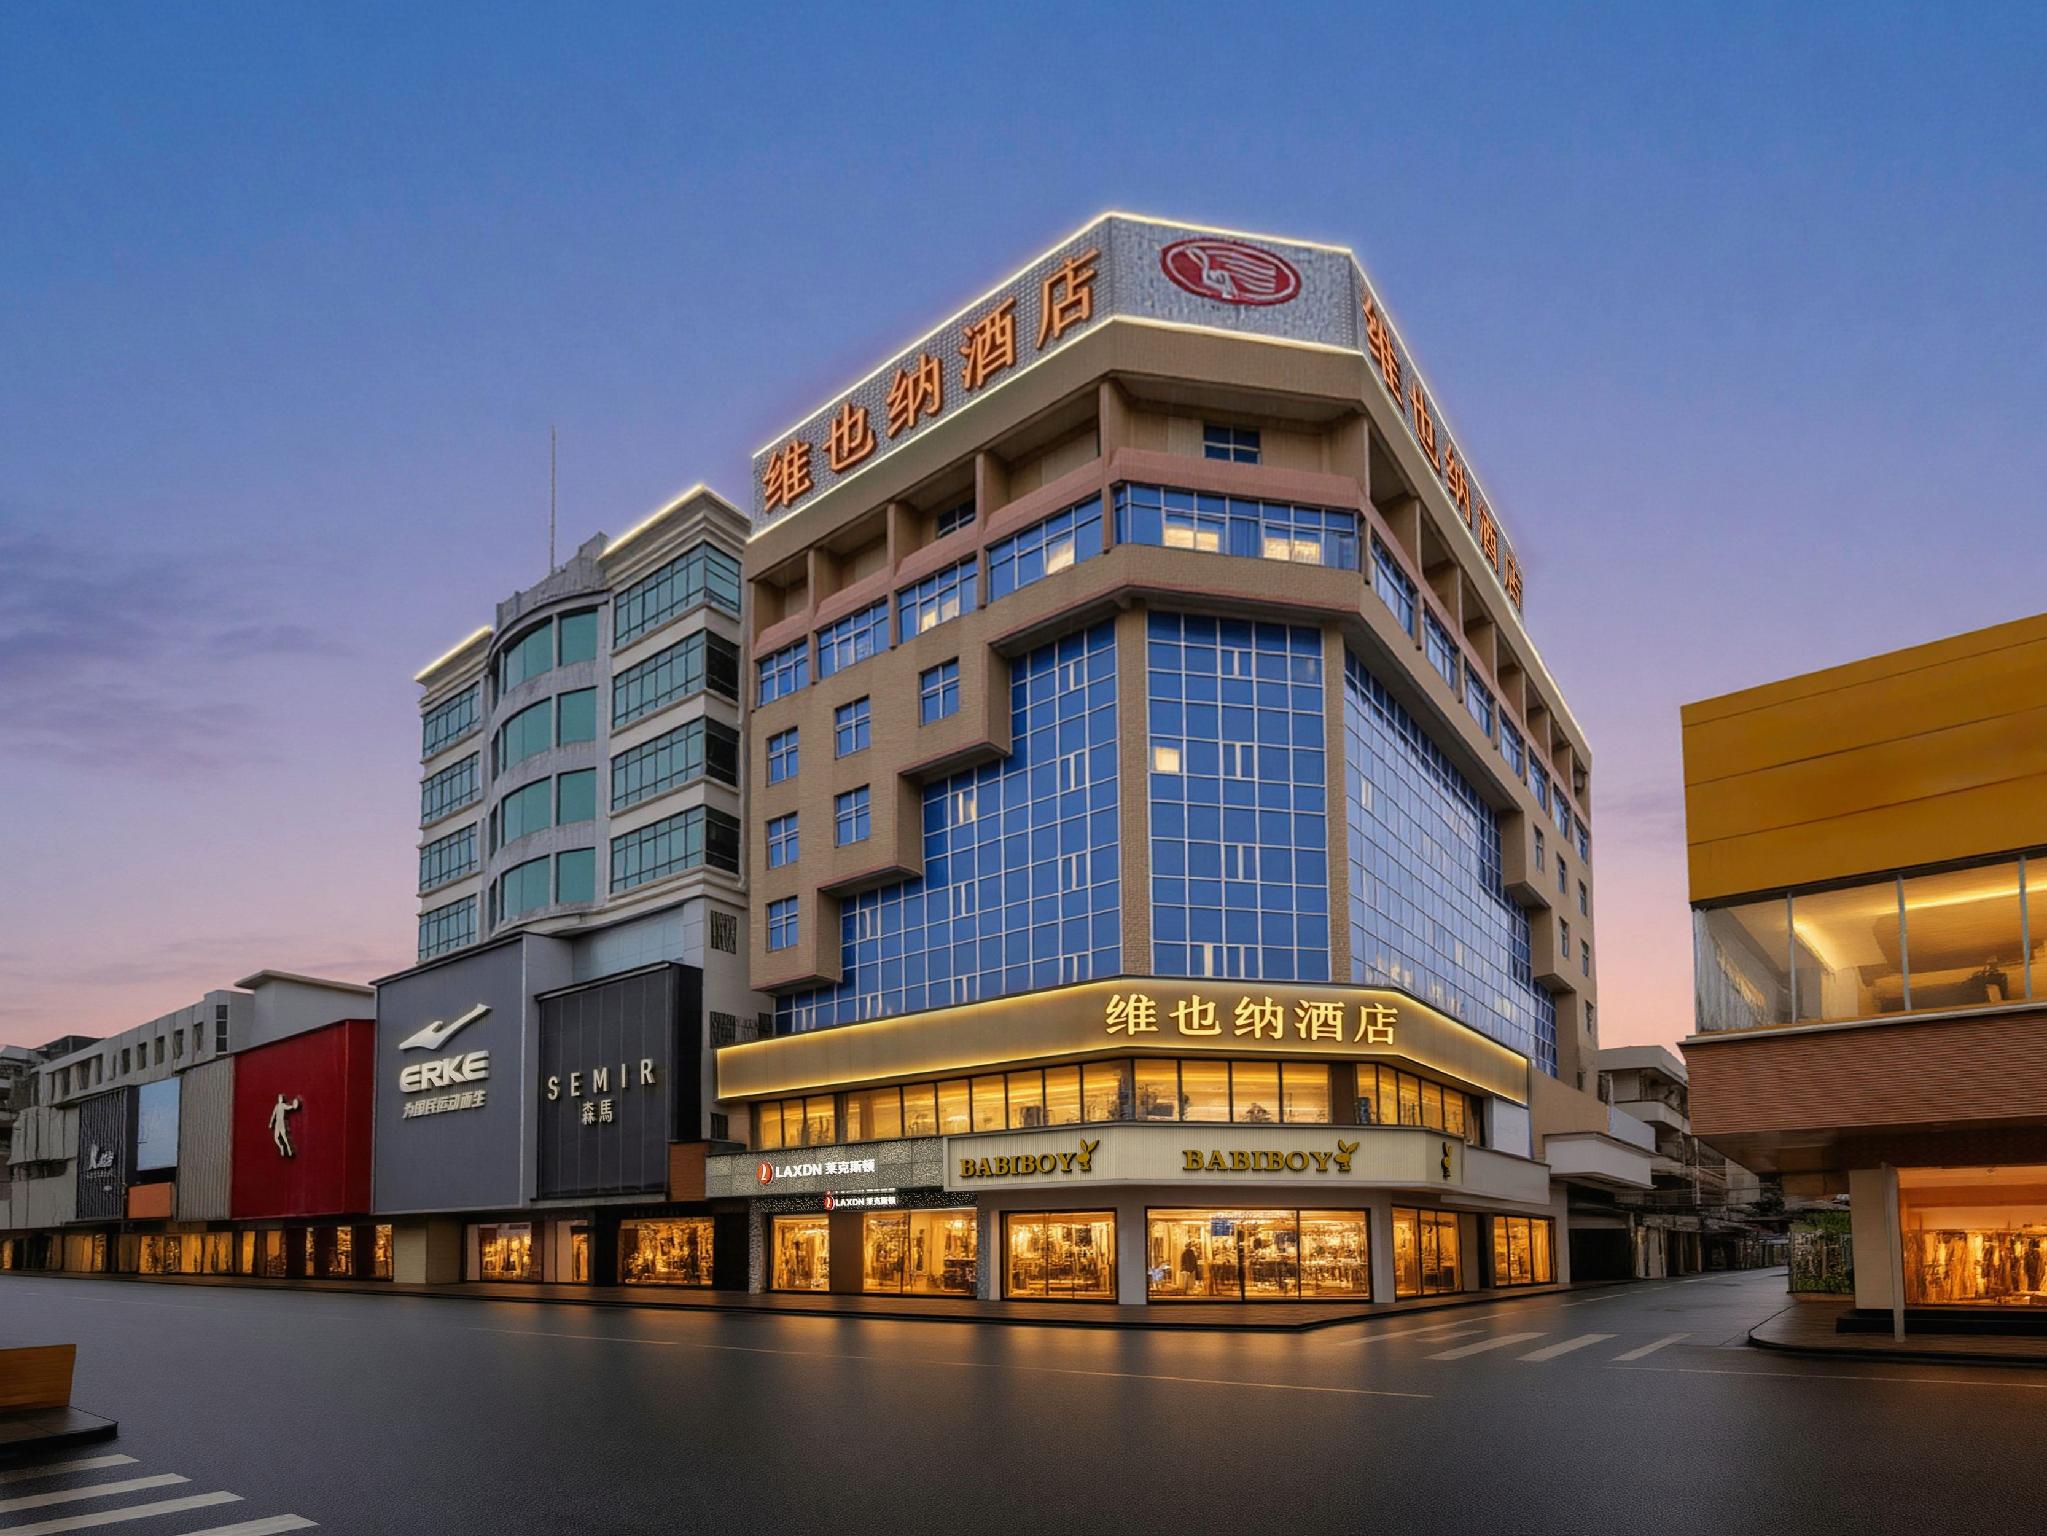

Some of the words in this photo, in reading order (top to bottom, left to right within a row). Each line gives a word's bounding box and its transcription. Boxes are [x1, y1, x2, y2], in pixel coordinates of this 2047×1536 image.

[763, 248, 1100, 513] 维也纳酒店
[1362, 295, 1521, 609] 维也纳酒店
[1105, 993, 1398, 1045] 维也纳酒店
[399, 1051, 489, 1093] ERKE
[547, 1058, 656, 1101] SEMIR
[582, 1099, 613, 1125] 森馬
[959, 1152, 1077, 1178] BABIBOY
[1182, 1149, 1334, 1172] BABIBOY
